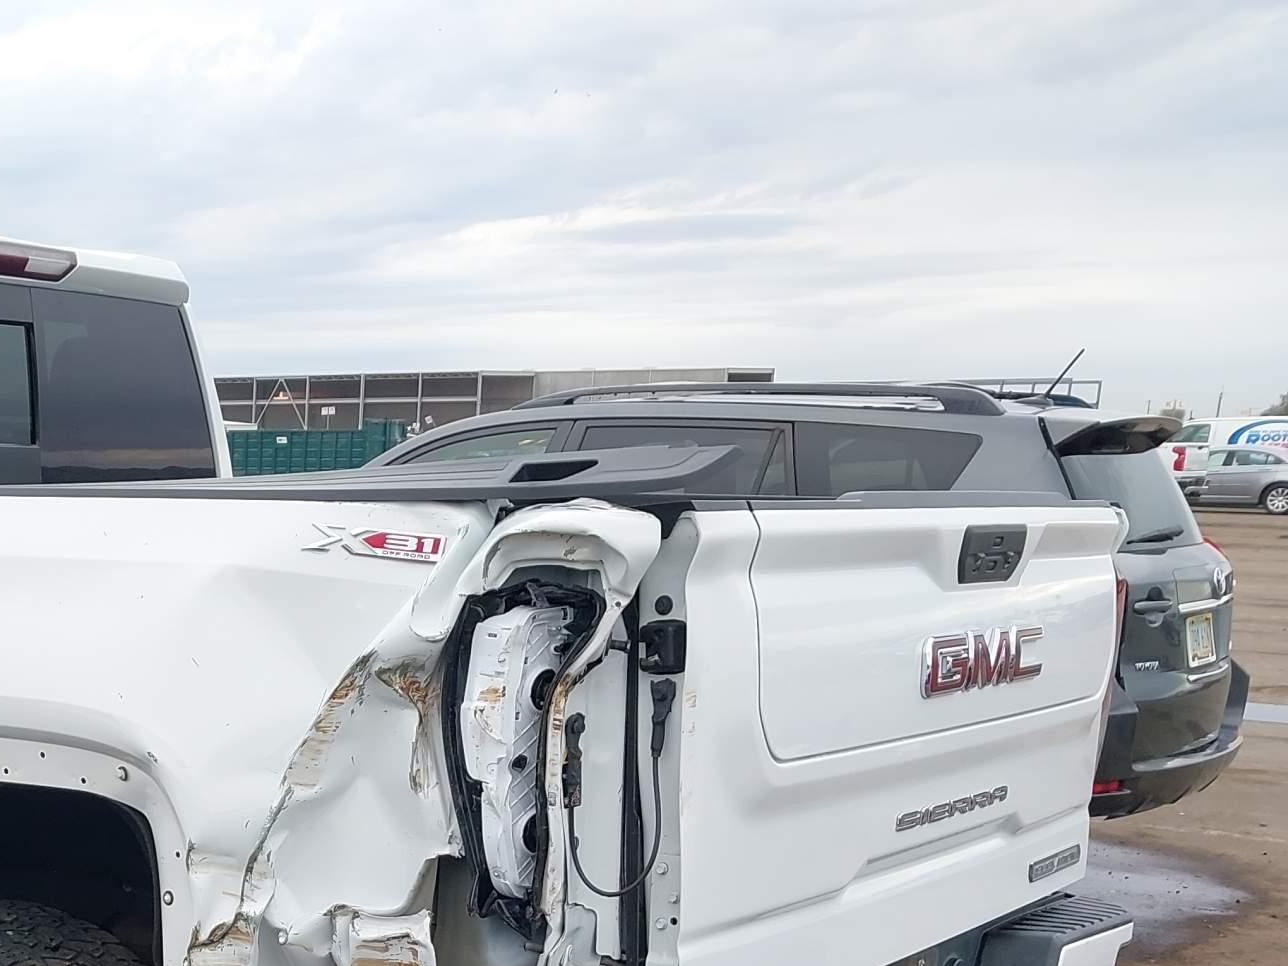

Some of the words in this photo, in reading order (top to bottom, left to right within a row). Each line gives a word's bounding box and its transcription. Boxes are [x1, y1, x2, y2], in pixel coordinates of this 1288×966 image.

[403, 552, 431, 560] ROAD
[920, 625, 1045, 699] GMC
[895, 785, 1008, 832] SIERRA
